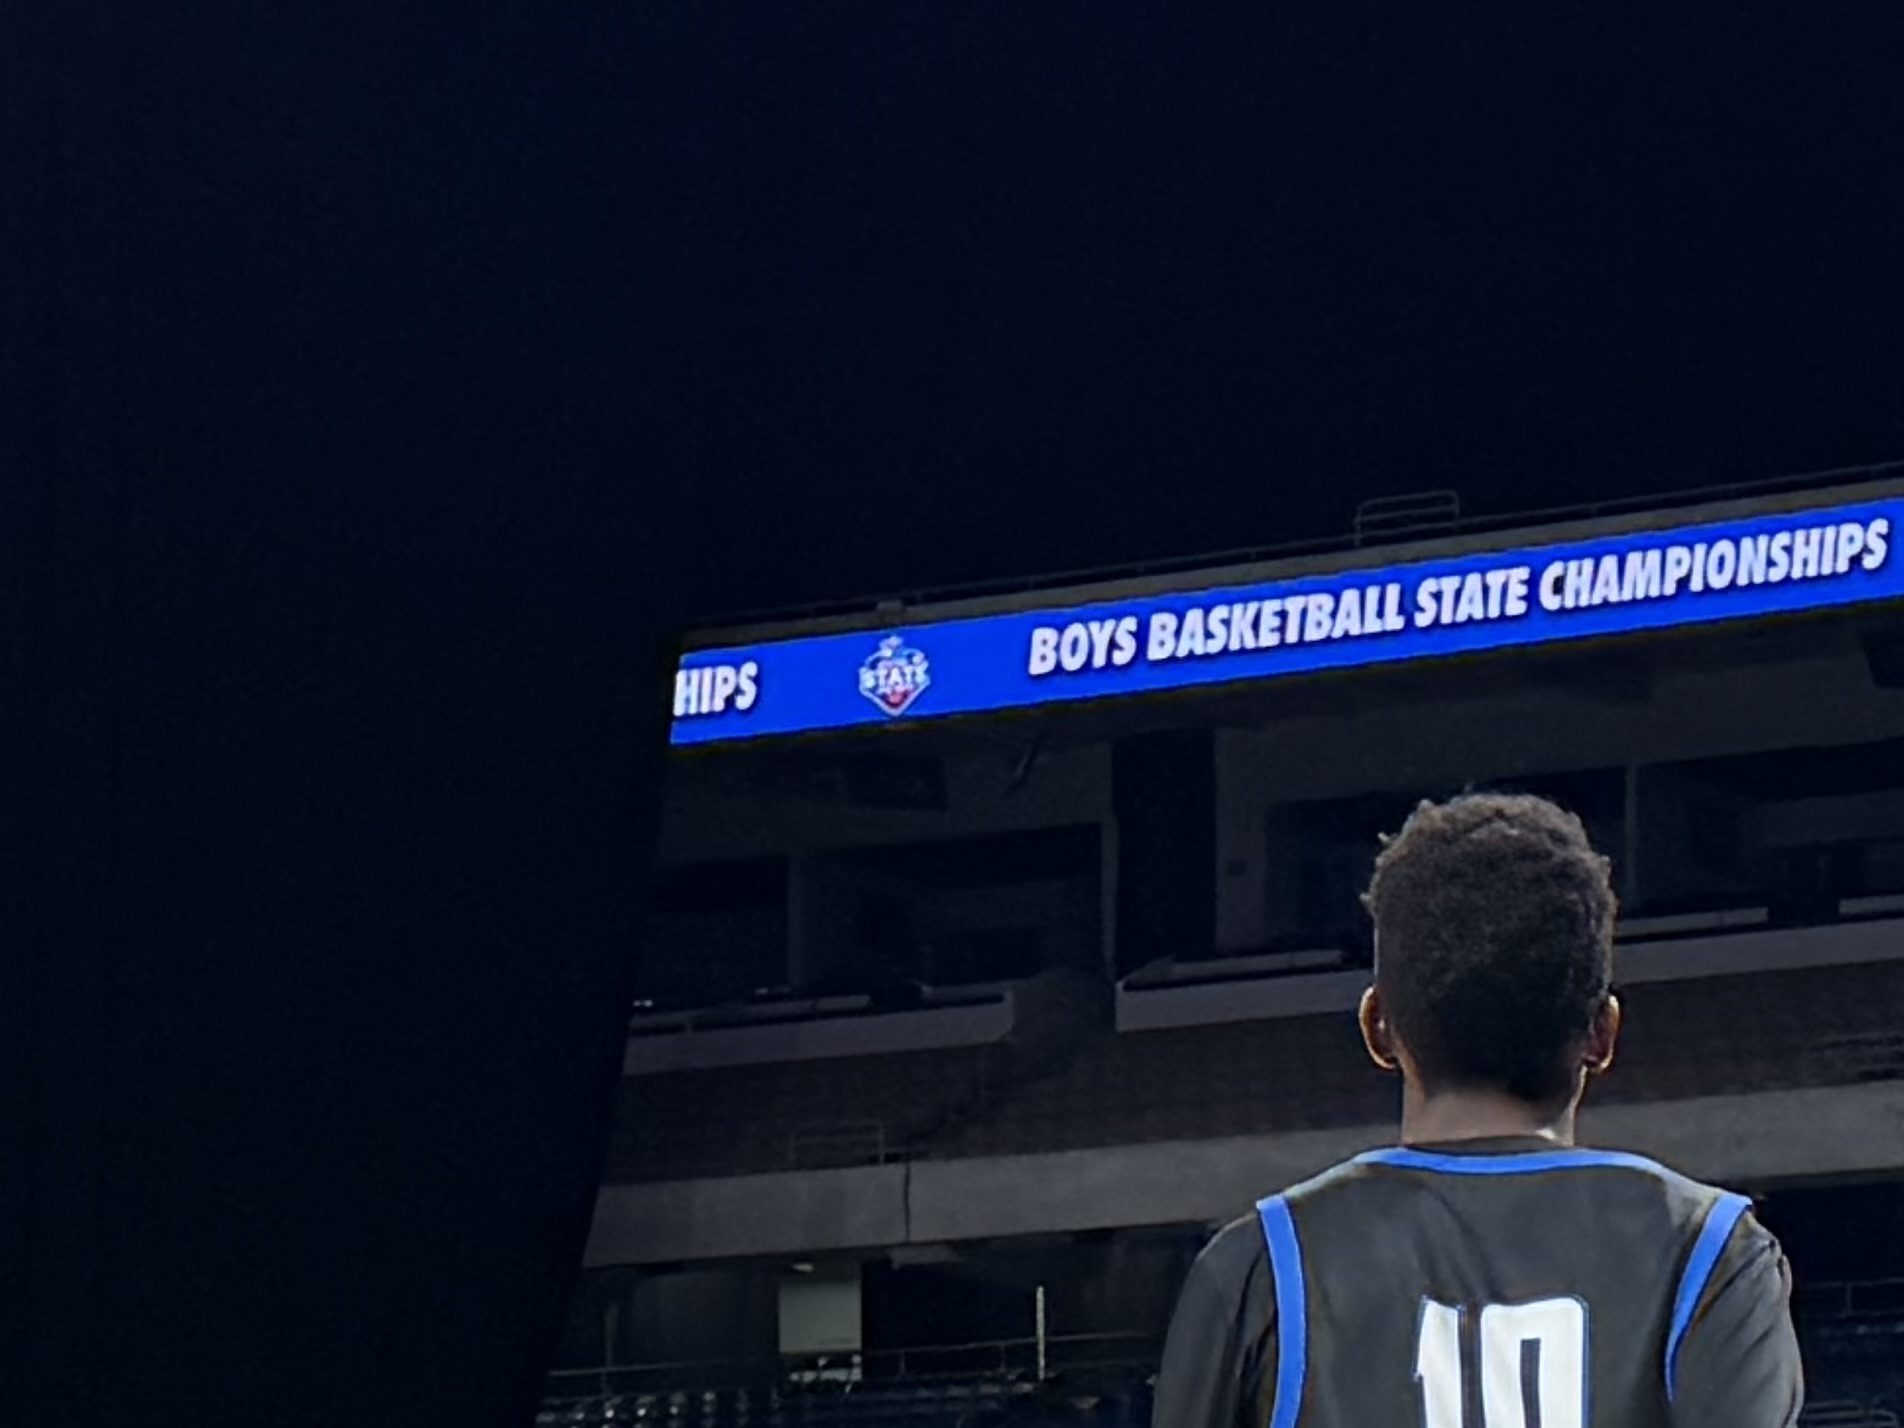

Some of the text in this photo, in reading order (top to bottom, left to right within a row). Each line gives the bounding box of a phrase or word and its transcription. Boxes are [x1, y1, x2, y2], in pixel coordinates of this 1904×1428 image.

[1027, 517, 1890, 676] BOYS BASKETBALL STATE CHAMPIONSHIPS
